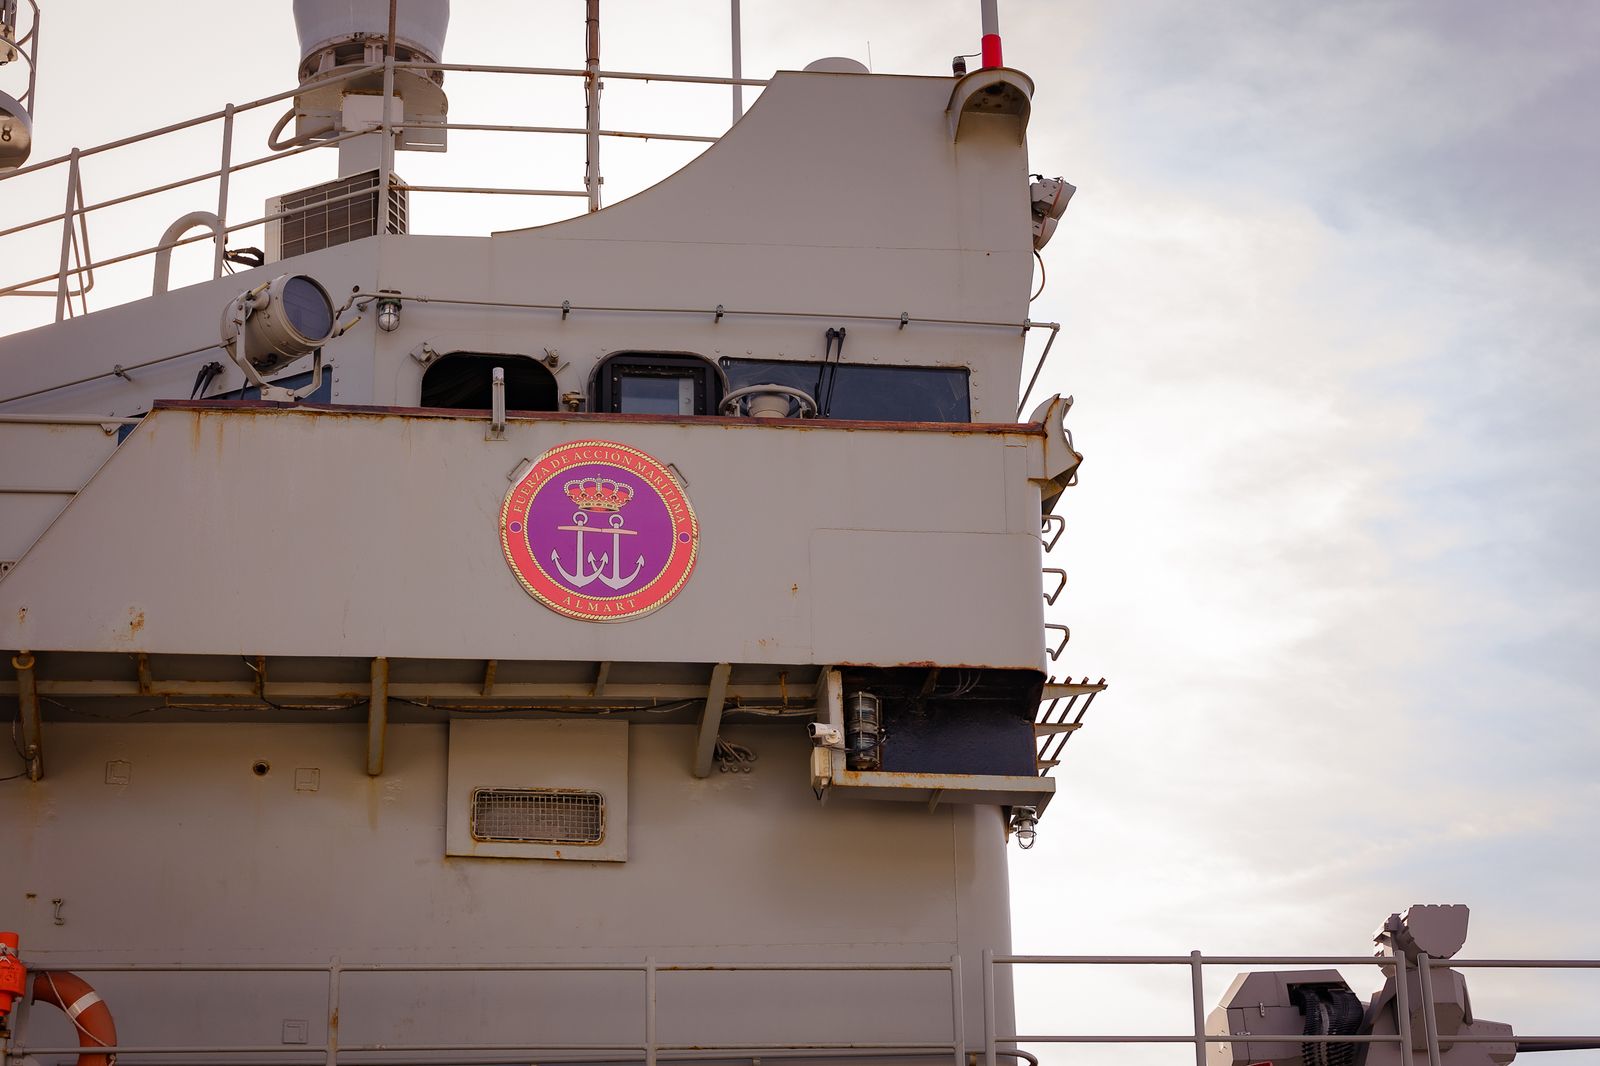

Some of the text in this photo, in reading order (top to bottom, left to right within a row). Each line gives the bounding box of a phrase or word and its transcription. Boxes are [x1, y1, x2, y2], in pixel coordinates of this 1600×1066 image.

[513, 449, 686, 523] FUERZA DE ACCIÓN MARÍTIMA
[562, 596, 637, 612] ALMART
